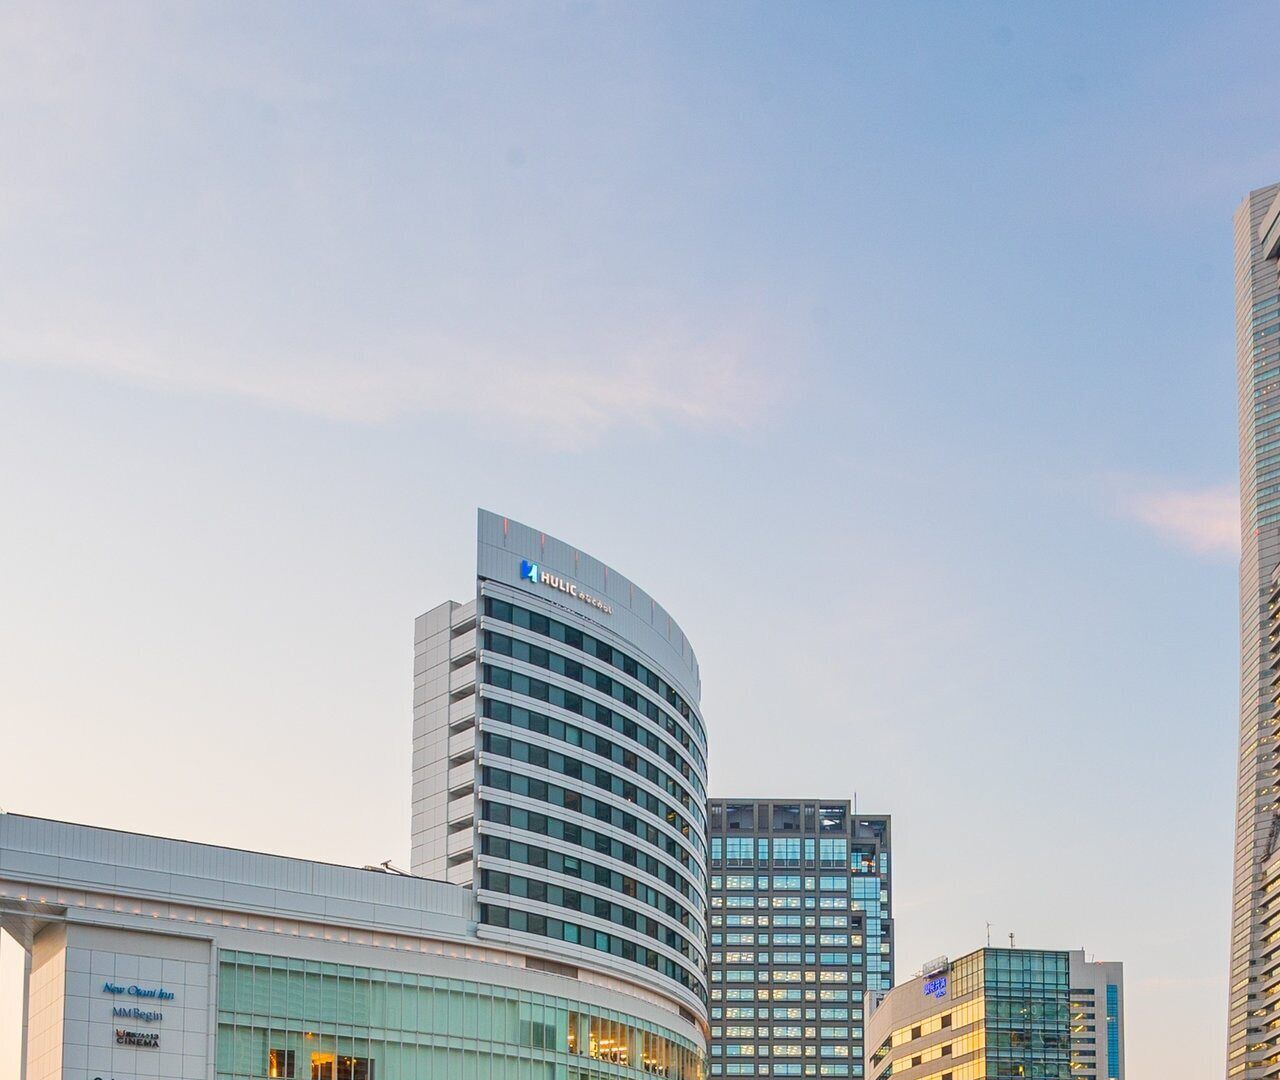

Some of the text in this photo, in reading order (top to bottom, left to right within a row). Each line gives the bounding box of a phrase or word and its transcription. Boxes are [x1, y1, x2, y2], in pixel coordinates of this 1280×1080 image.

[541, 571, 577, 596] HULIC
[102, 982, 175, 1000] New Otani Inn
[116, 1037, 160, 1048] CINEMA
